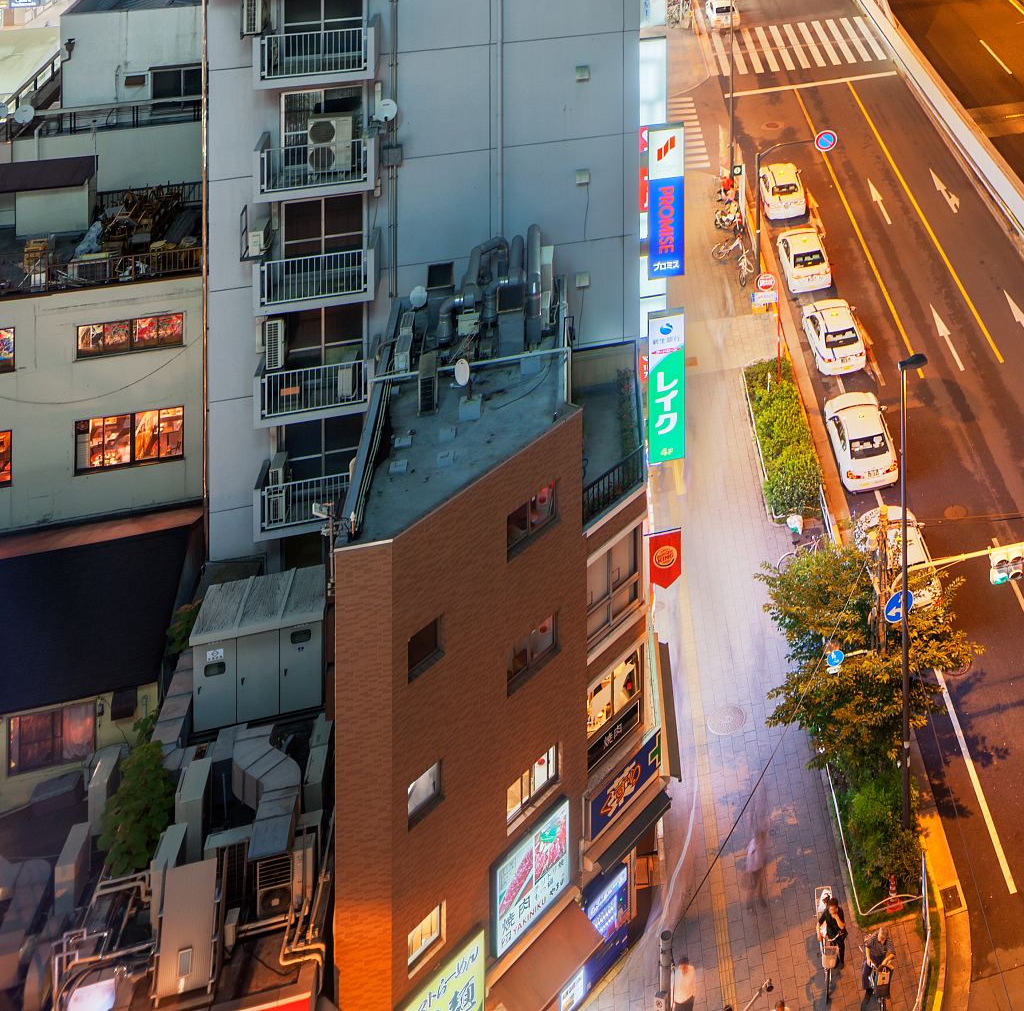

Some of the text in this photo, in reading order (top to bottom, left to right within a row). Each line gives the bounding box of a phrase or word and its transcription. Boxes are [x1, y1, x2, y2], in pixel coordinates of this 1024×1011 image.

[658, 186, 675, 255] PROMISE
[653, 260, 680, 272] プロミス
[652, 335, 681, 345] 新生銀行
[654, 371, 679, 436] レイク
[659, 446, 674, 457] 4F
[657, 554, 674, 565] KING
[501, 895, 531, 937] 焼肉
[512, 895, 548, 936] YAKINIKU
